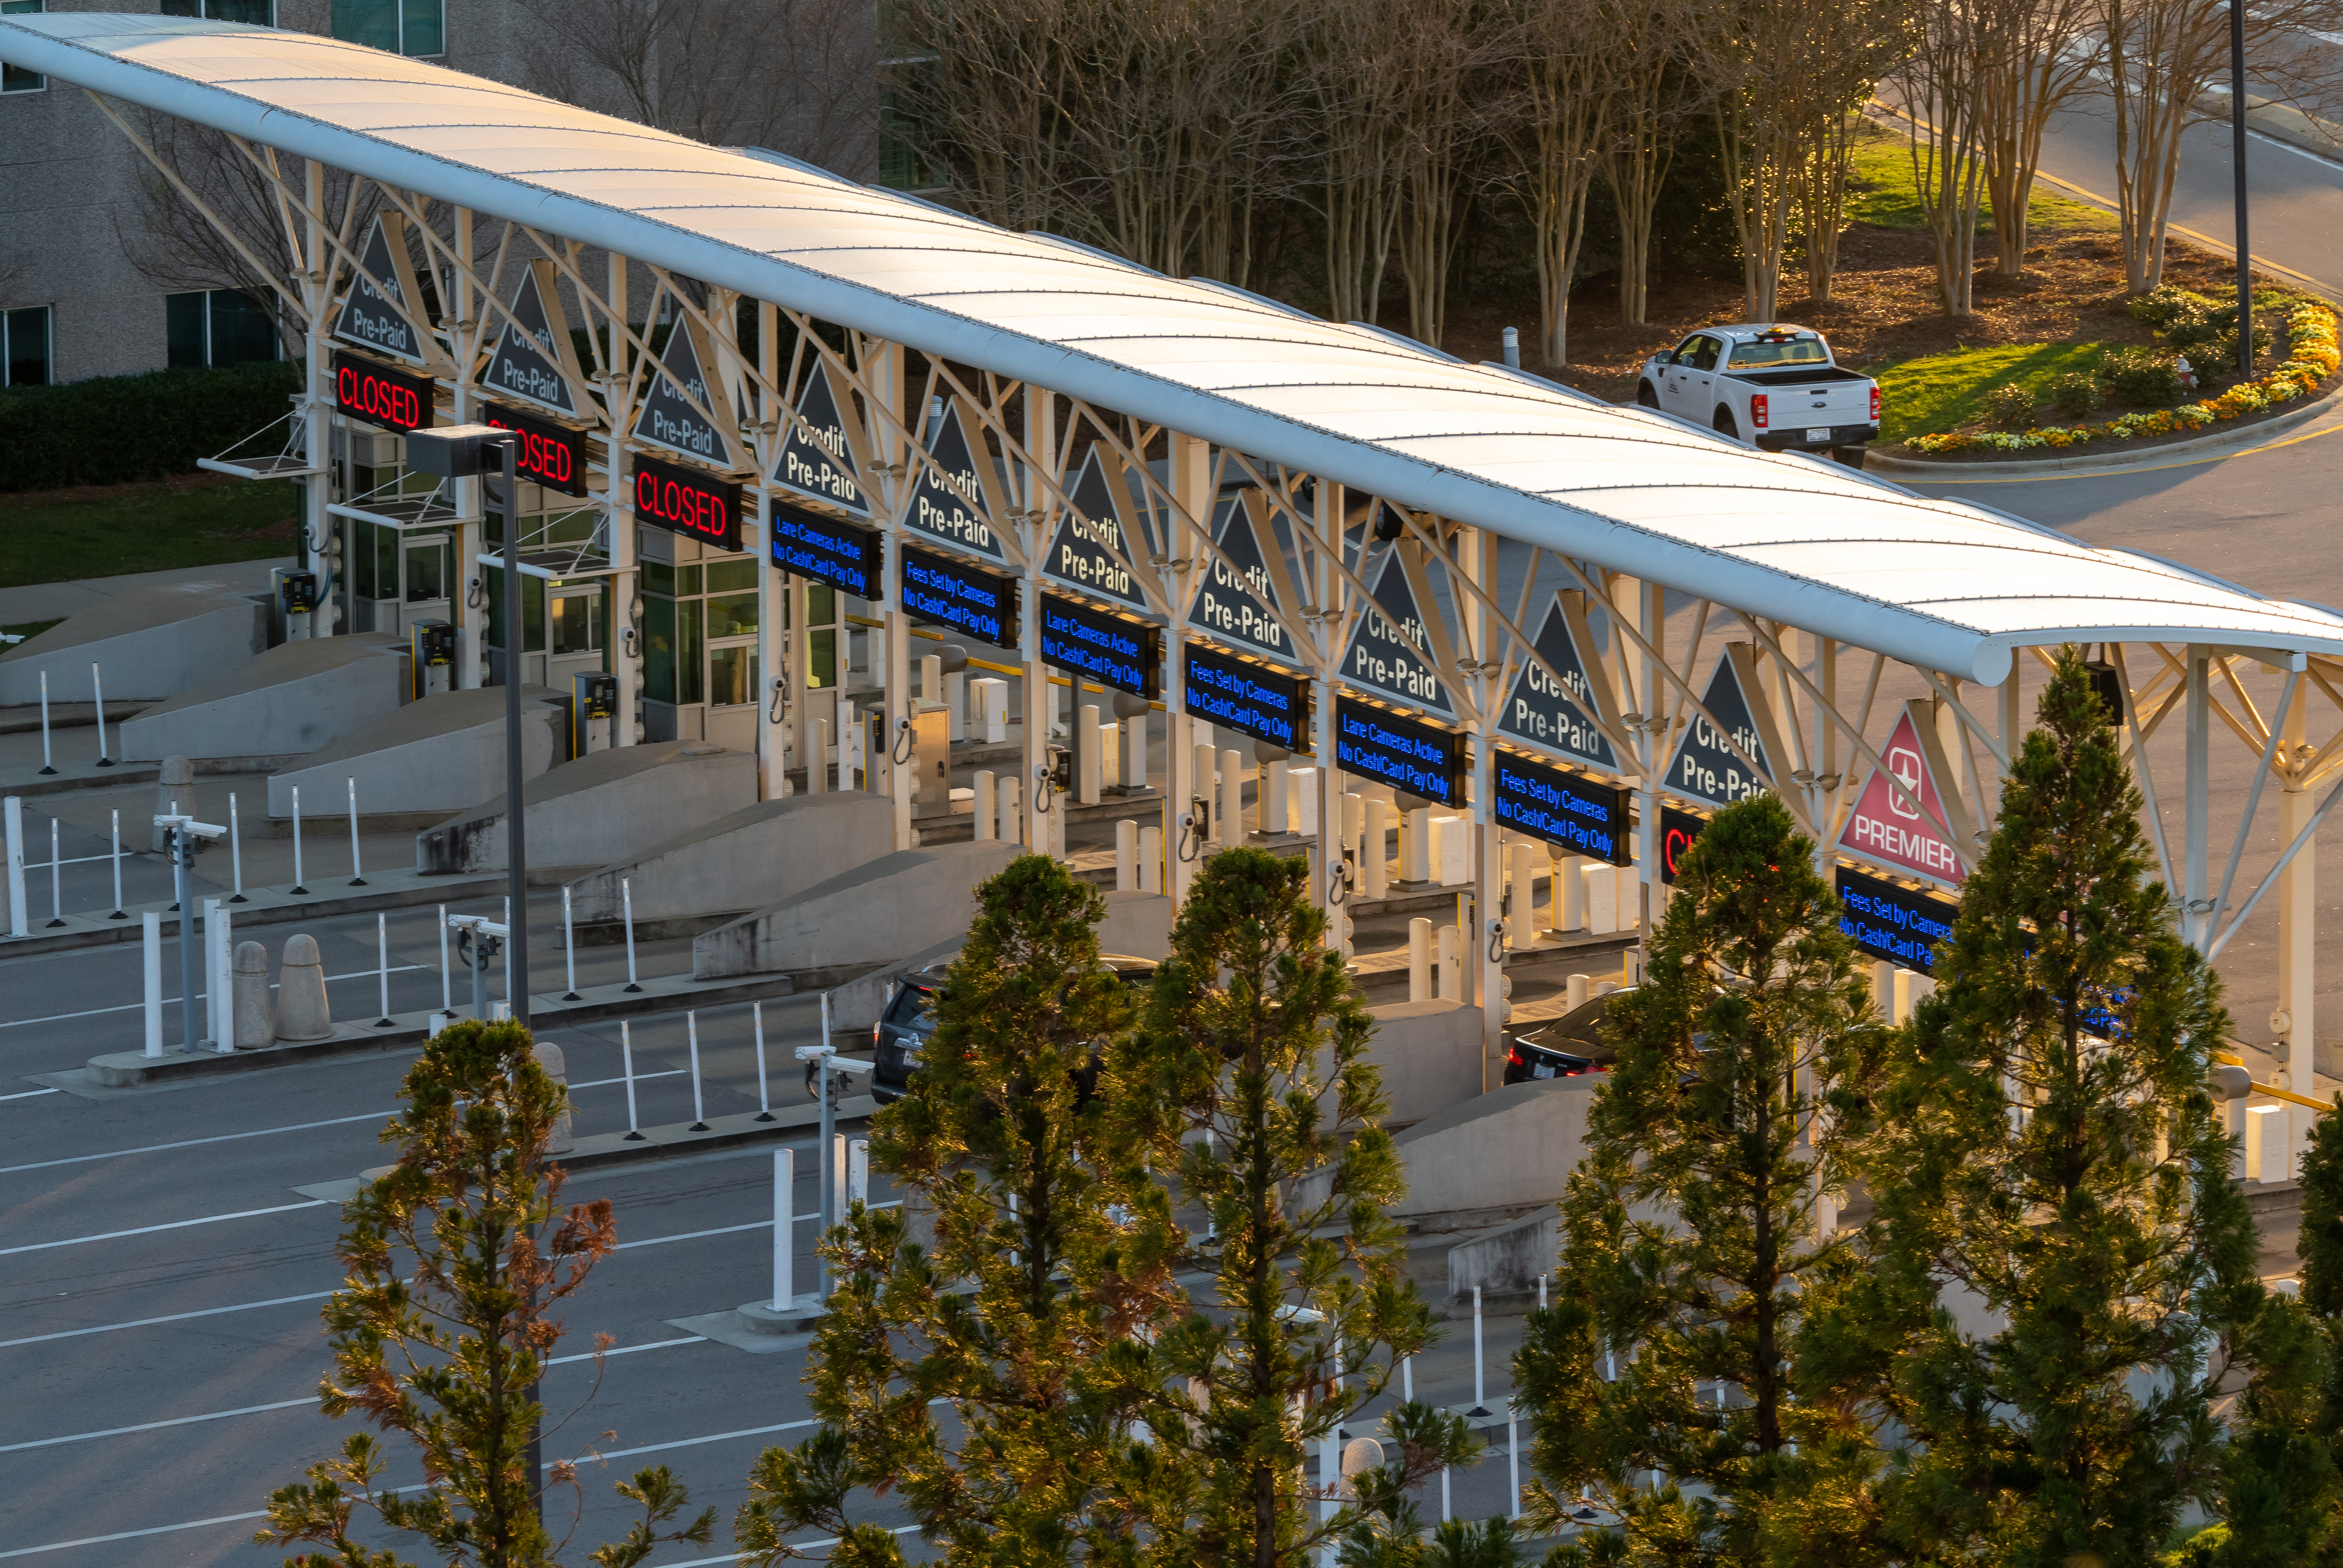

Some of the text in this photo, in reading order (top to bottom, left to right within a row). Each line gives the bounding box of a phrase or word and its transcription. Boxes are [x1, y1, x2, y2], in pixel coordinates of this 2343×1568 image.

[354, 308, 406, 350] Pre-Paid
[339, 367, 419, 428] CLOSED
[504, 358, 558, 402] Pre-Paid
[489, 419, 571, 482] OSED
[653, 409, 712, 454] Pre-Paid
[788, 451, 855, 501] Pre-Paid
[637, 471, 726, 536] CLOSED
[919, 496, 989, 547] Pre-Paid
[776, 516, 861, 560] Lane Cameras Active
[773, 541, 785, 560] No
[830, 561, 847, 585] Pay
[847, 567, 866, 592] Only
[907, 561, 996, 607] Fees Set by Cameras
[1062, 544, 1129, 595] Pre-Paid
[903, 587, 916, 606] No
[962, 608, 980, 633] Pay
[980, 615, 1000, 640] Only
[1047, 610, 1138, 657] Lane Cameras Active
[1204, 592, 1280, 647] Pre-Paid
[1368, 607, 1423, 651] Credit
[1043, 636, 1056, 656] No
[1104, 658, 1123, 684] Pay
[1122, 665, 1143, 690] Only
[1191, 660, 1288, 710] Fees Set by Cameras
[1356, 644, 1436, 701] Pre-Paid
[1528, 659, 1586, 703] Credit
[1187, 687, 1201, 707] No
[1252, 710, 1271, 736] Pay
[1271, 717, 1293, 743] Only
[1343, 714, 1443, 764] Lane Cameras Active
[1516, 698, 1599, 755] Pre-Paid
[1338, 741, 1353, 761] No
[1406, 764, 1426, 792] Pay
[1426, 772, 1449, 800] Only
[1501, 769, 1608, 822] Fees Set by Cameras
[1497, 796, 1512, 818] No
[1568, 821, 1589, 849] Pay
[1589, 829, 1613, 857] Only
[1855, 814, 1955, 874] PREMIER
[1843, 886, 1872, 912] Fees
[1873, 896, 1893, 921] Set
[1893, 903, 1908, 930] by
[1916, 943, 1934, 966] Pa
